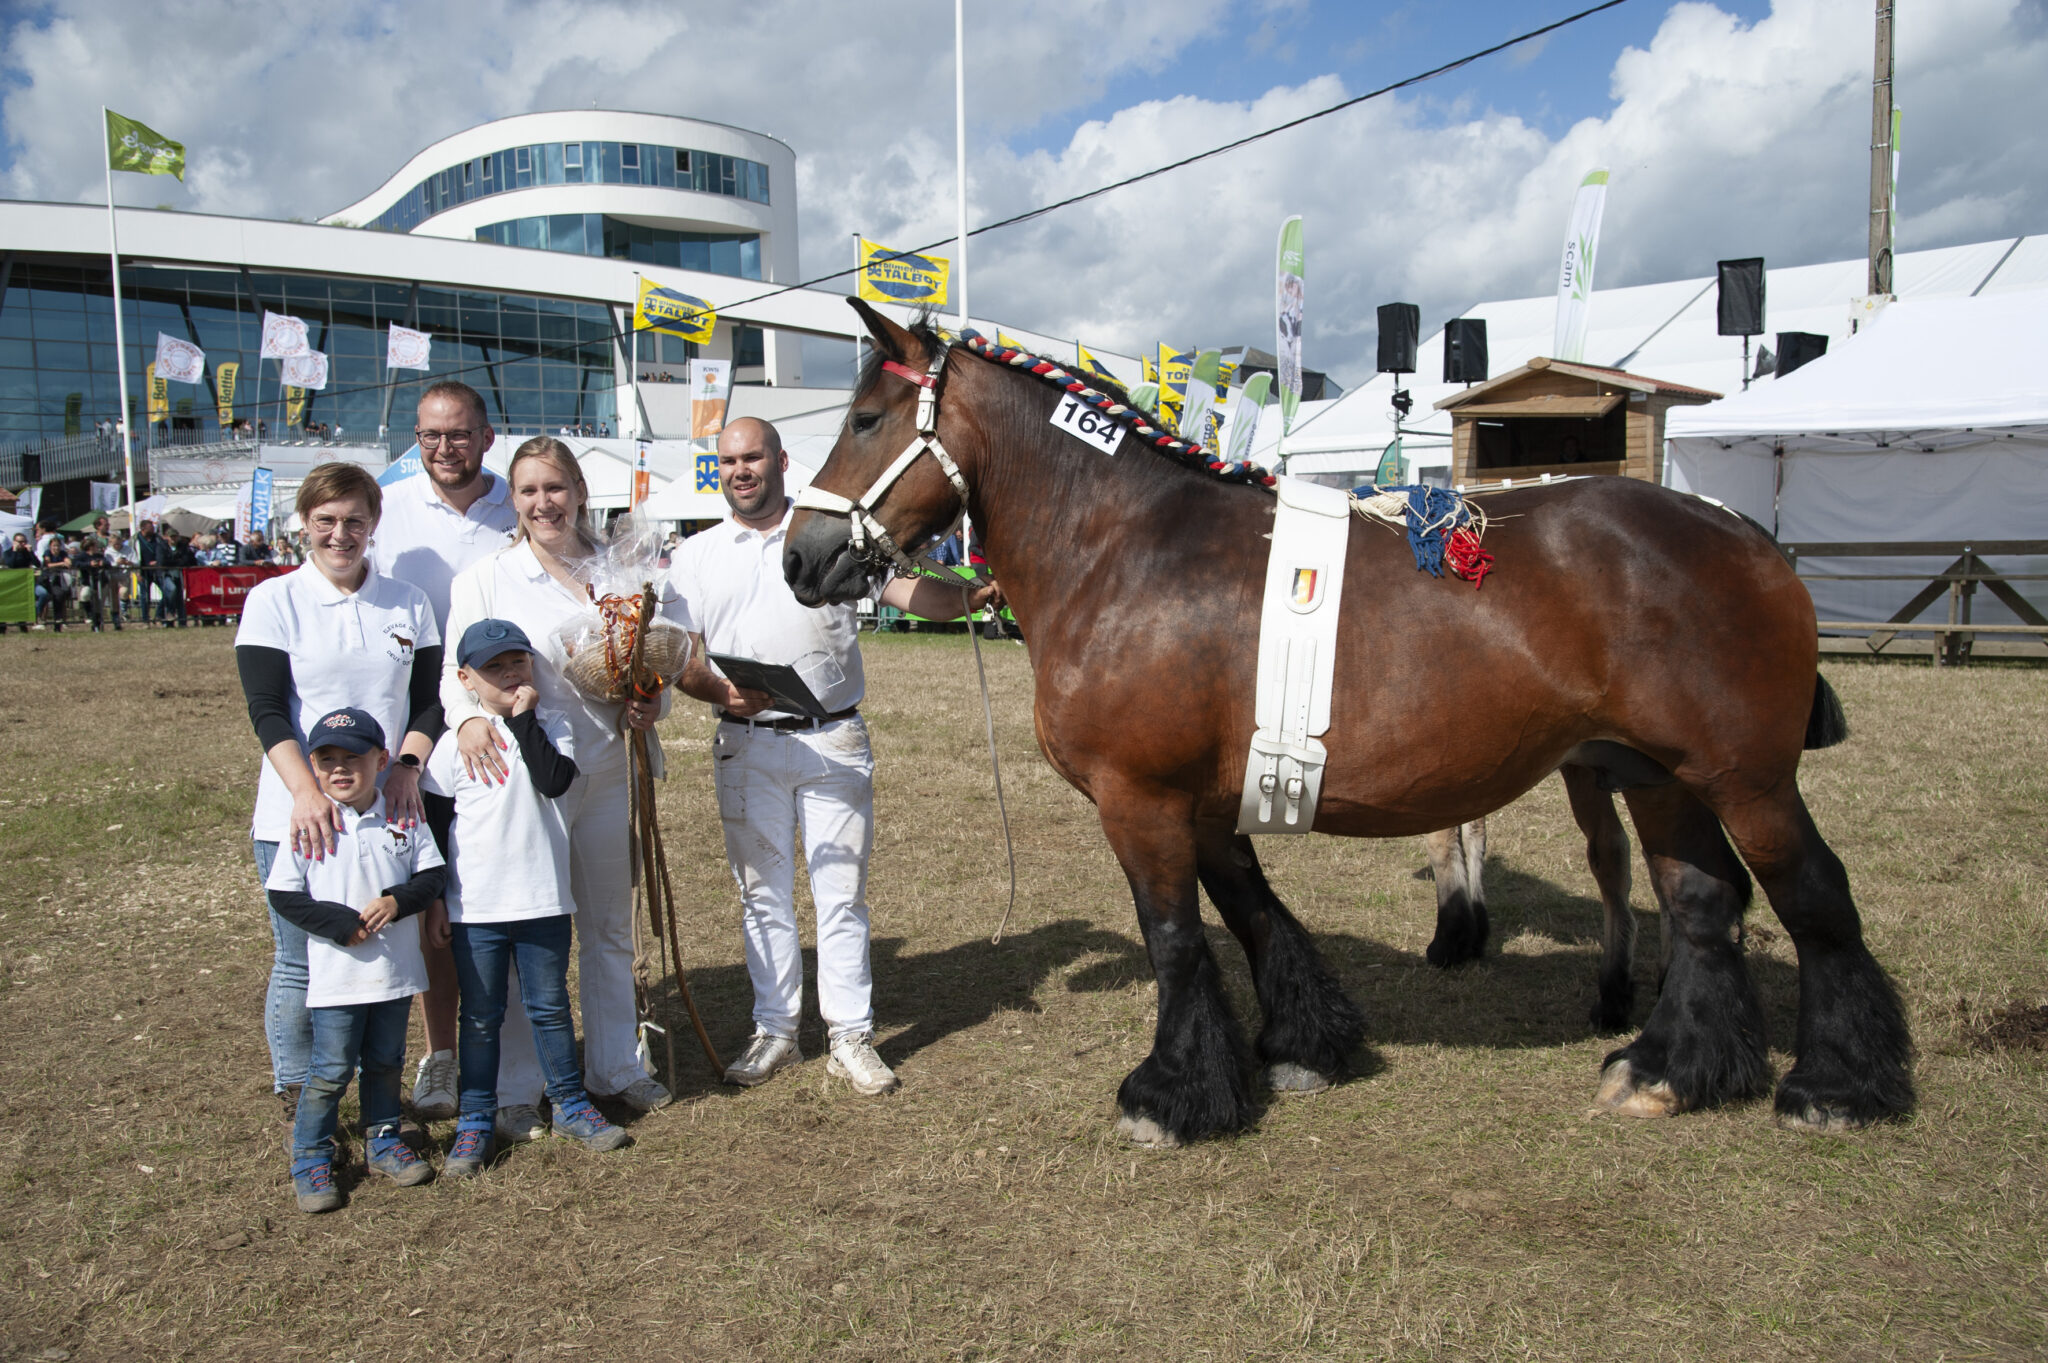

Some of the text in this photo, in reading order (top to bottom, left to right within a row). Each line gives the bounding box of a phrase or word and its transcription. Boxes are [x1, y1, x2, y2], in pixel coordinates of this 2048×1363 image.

[1563, 241, 1576, 288] scam
[883, 268, 942, 289] TALBOT
[658, 305, 710, 326] TALBOT
[1063, 401, 1119, 445] 164
[254, 471, 270, 531] RMILK
[382, 623, 406, 634] ELEVAGE
[386, 649, 401, 664] DEUX
